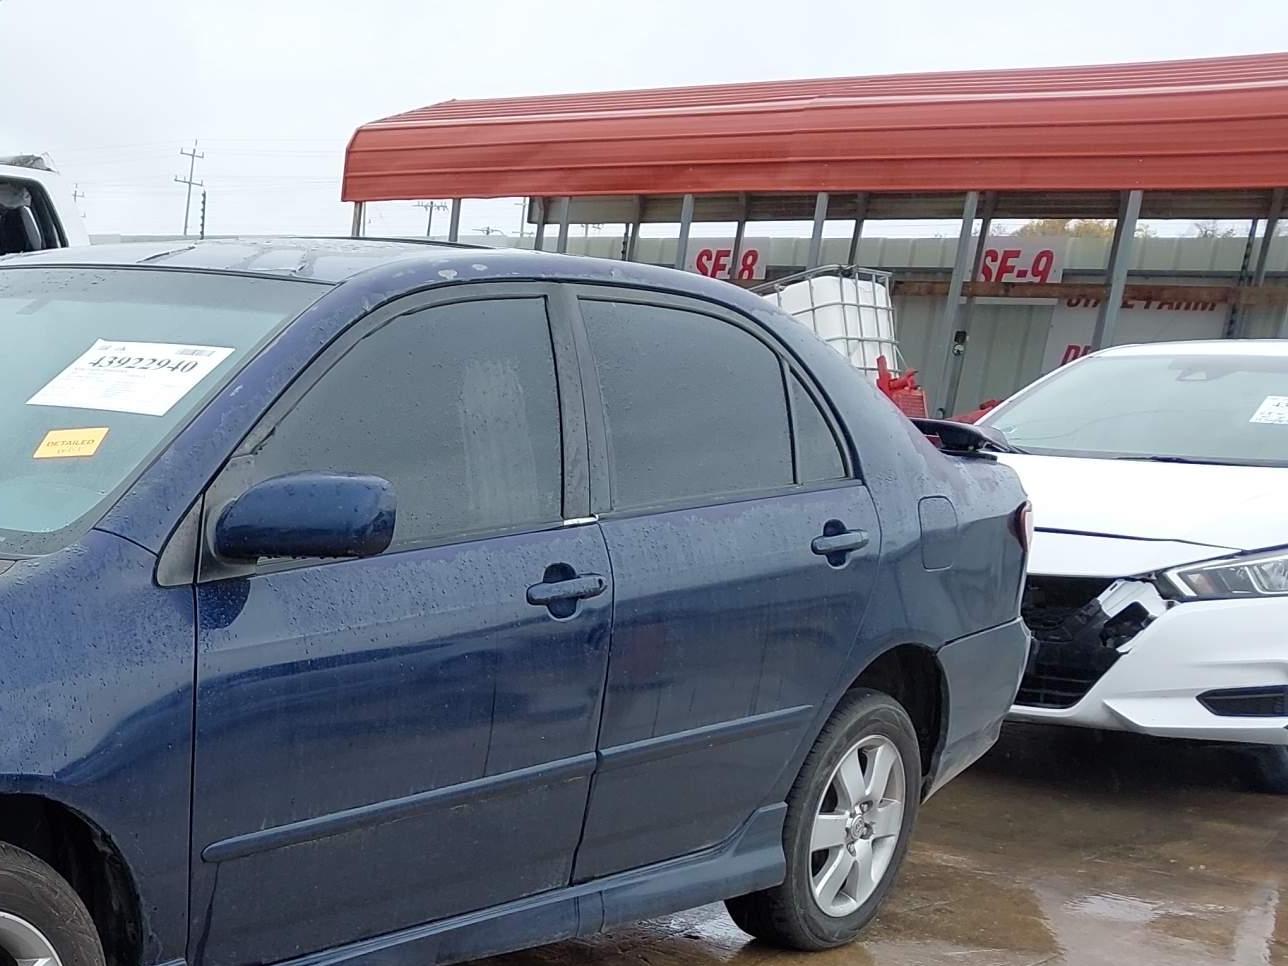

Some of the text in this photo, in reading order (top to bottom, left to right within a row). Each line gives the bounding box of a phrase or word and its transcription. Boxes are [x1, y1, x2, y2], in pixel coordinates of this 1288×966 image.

[696, 248, 759, 280] SF8
[88, 355, 199, 374] 43922940
[46, 439, 95, 448] DETAILED
